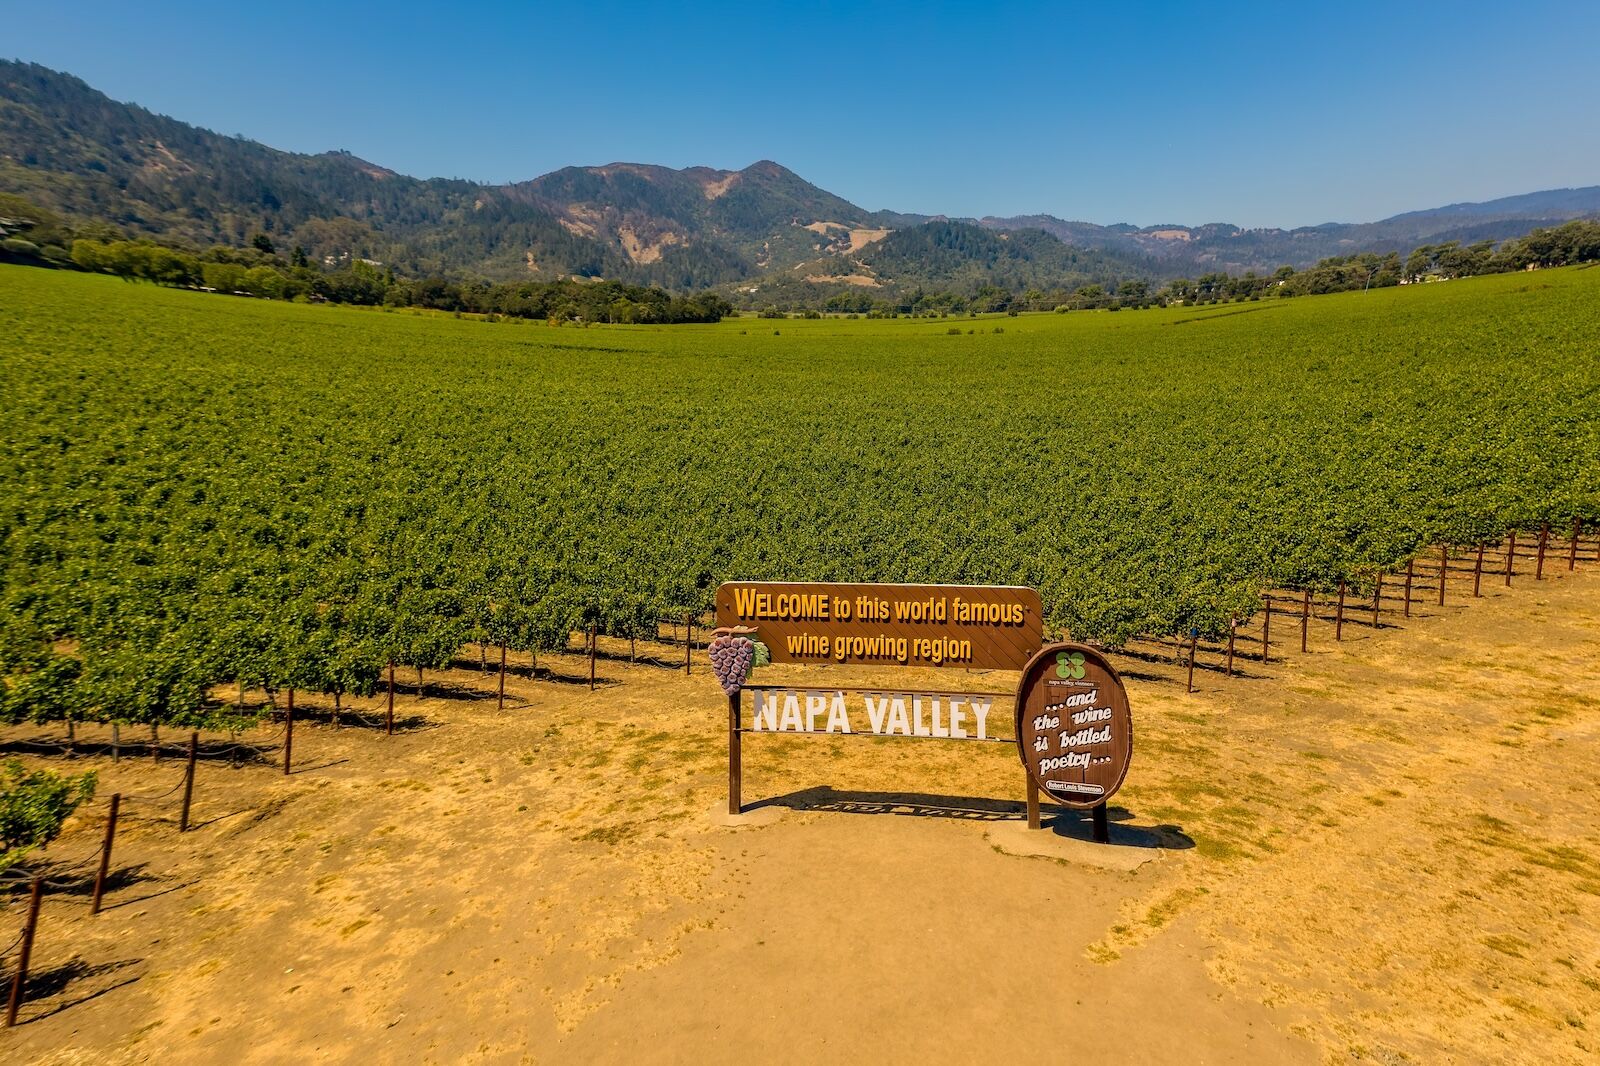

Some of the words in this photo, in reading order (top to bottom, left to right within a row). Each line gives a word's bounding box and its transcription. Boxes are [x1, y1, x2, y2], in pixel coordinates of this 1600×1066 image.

[734, 588, 829, 618] WELCOME
[833, 596, 851, 619] to
[856, 596, 890, 619] this
[894, 597, 947, 621] world
[953, 597, 1024, 623] famous
[787, 632, 830, 654] wine
[835, 634, 908, 662] growing
[913, 636, 971, 663] region
[753, 688, 851, 734] NAPA
[863, 691, 992, 740] VALLEY
[1033, 714, 1060, 731] the
[1072, 706, 1112, 725] wine
[1033, 736, 1049, 752] is
[1059, 725, 1112, 748] bottled
